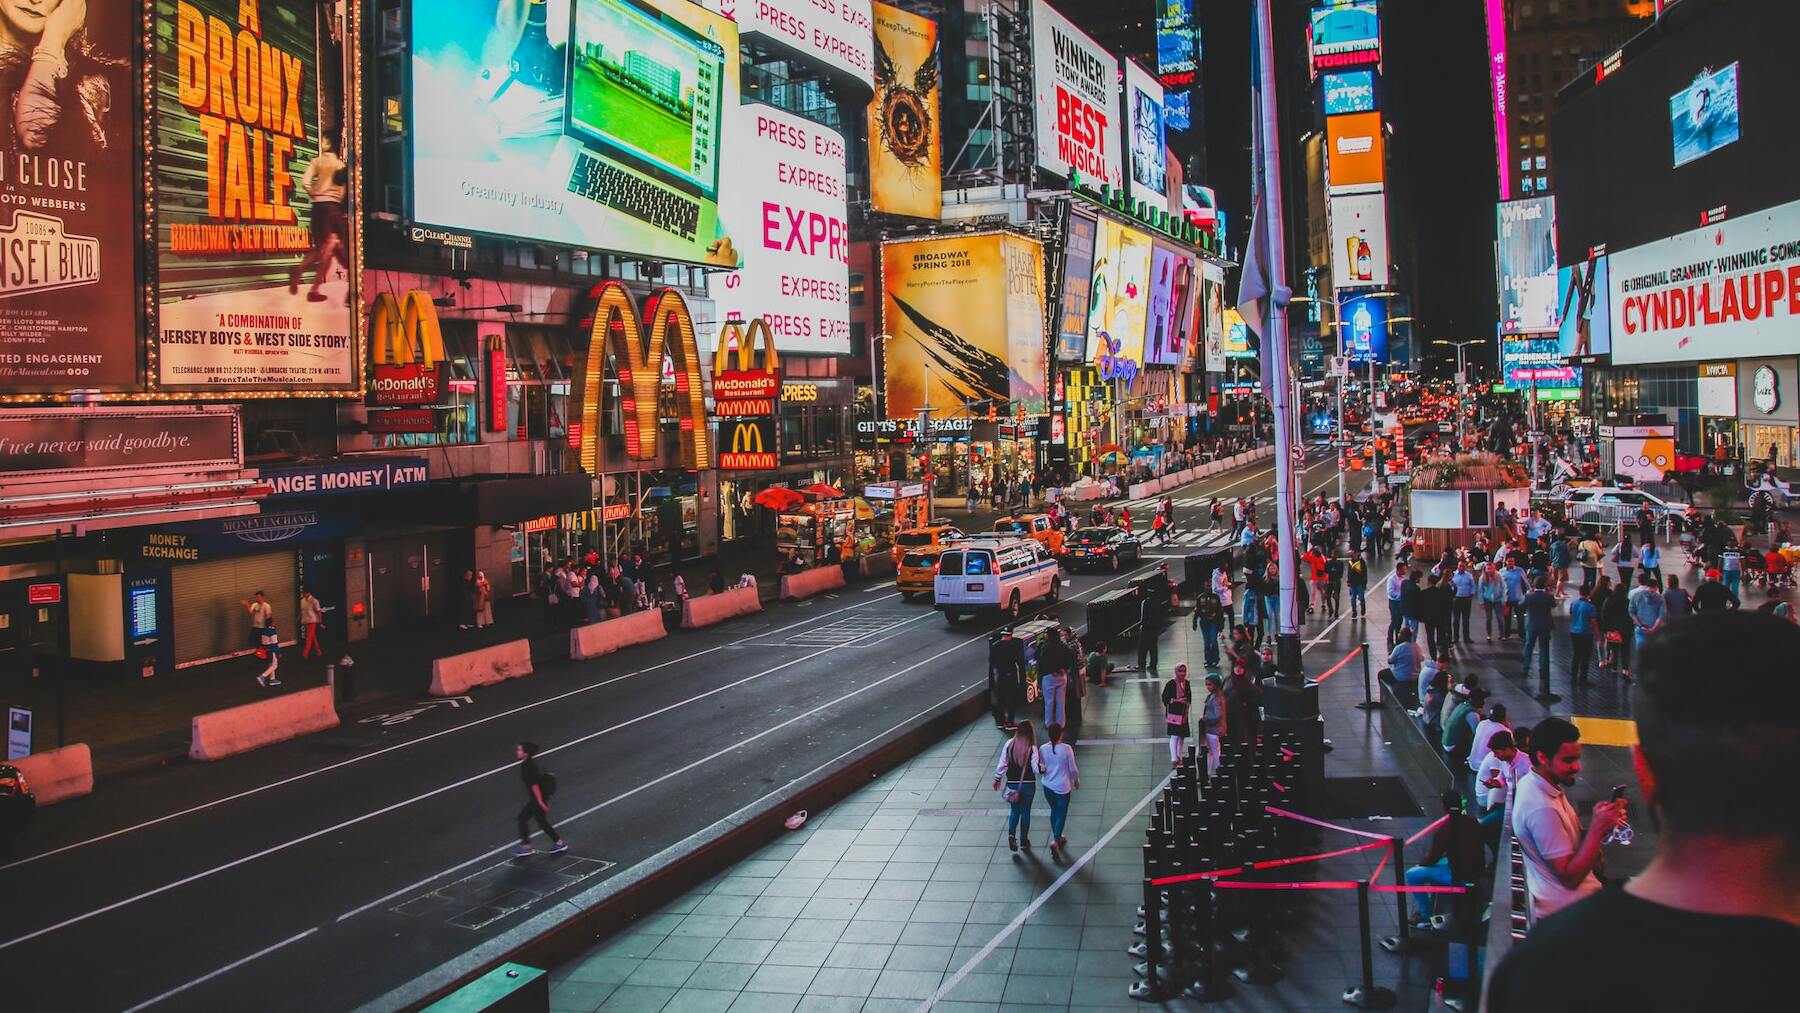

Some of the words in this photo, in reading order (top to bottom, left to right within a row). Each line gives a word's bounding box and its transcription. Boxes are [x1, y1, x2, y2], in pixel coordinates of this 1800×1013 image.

[238, 0, 260, 33] A
[814, 28, 868, 71] EXPRESS
[1052, 27, 1107, 89] WINNER!
[1315, 50, 1379, 68] TOSHIBA
[178, 0, 304, 138] BRONX
[1055, 60, 1060, 74] 6
[1062, 63, 1079, 87] TONY
[1081, 79, 1107, 105] AWARDS
[1056, 85, 1108, 155] BEST
[758, 116, 806, 150] PRESS
[200, 114, 292, 221] TALE
[1058, 134, 1109, 182] MUSICAL
[20, 153, 87, 191] CLOSE
[778, 162, 838, 197] EXPRESS
[31, 197, 86, 211] WEBBER'S
[461, 181, 517, 207] Creativity
[521, 190, 564, 215] Industry
[1501, 204, 1542, 221] What
[25, 222, 47, 236] 10086
[171, 223, 240, 251] BROADWAY'S
[242, 225, 261, 249] NEW
[263, 226, 277, 249] HIT
[278, 227, 310, 249] MUSICAL
[60, 242, 97, 281] BLVD.
[912, 260, 947, 270] SPRING
[951, 259, 971, 267] 2018
[913, 251, 969, 262] BROADWAY
[781, 275, 841, 302] EXPRESS
[907, 278, 978, 288] HarryPotterThePlay.com
[1631, 269, 1668, 291] ORIGINAL
[1623, 286, 1696, 336] CYNDI
[1703, 266, 1800, 326] LAUPE
[228, 313, 290, 329] COMBINATION
[292, 317, 303, 329] OF
[160, 330, 207, 345] JERSEY
[210, 331, 241, 346] BOYS
[244, 332, 253, 346] &
[254, 332, 286, 347] WEST
[288, 334, 311, 348] SIDE
[26, 354, 102, 363] ENGAGEMENT
[370, 378, 435, 391] McDonald's
[715, 378, 775, 390] McDonald's
[9, 443, 34, 455] we
[37, 440, 84, 454] never
[86, 433, 123, 451] said
[124, 431, 192, 454] goodbye.
[258, 474, 316, 494] ANGE
[321, 469, 383, 490] MONEY
[393, 466, 427, 484] ATM
[223, 519, 261, 532] MONEY
[264, 513, 318, 529] EXCHANGE
[150, 533, 187, 547] MONEY
[142, 546, 198, 560] EXCHANGE
[131, 578, 157, 587] CHANGE
